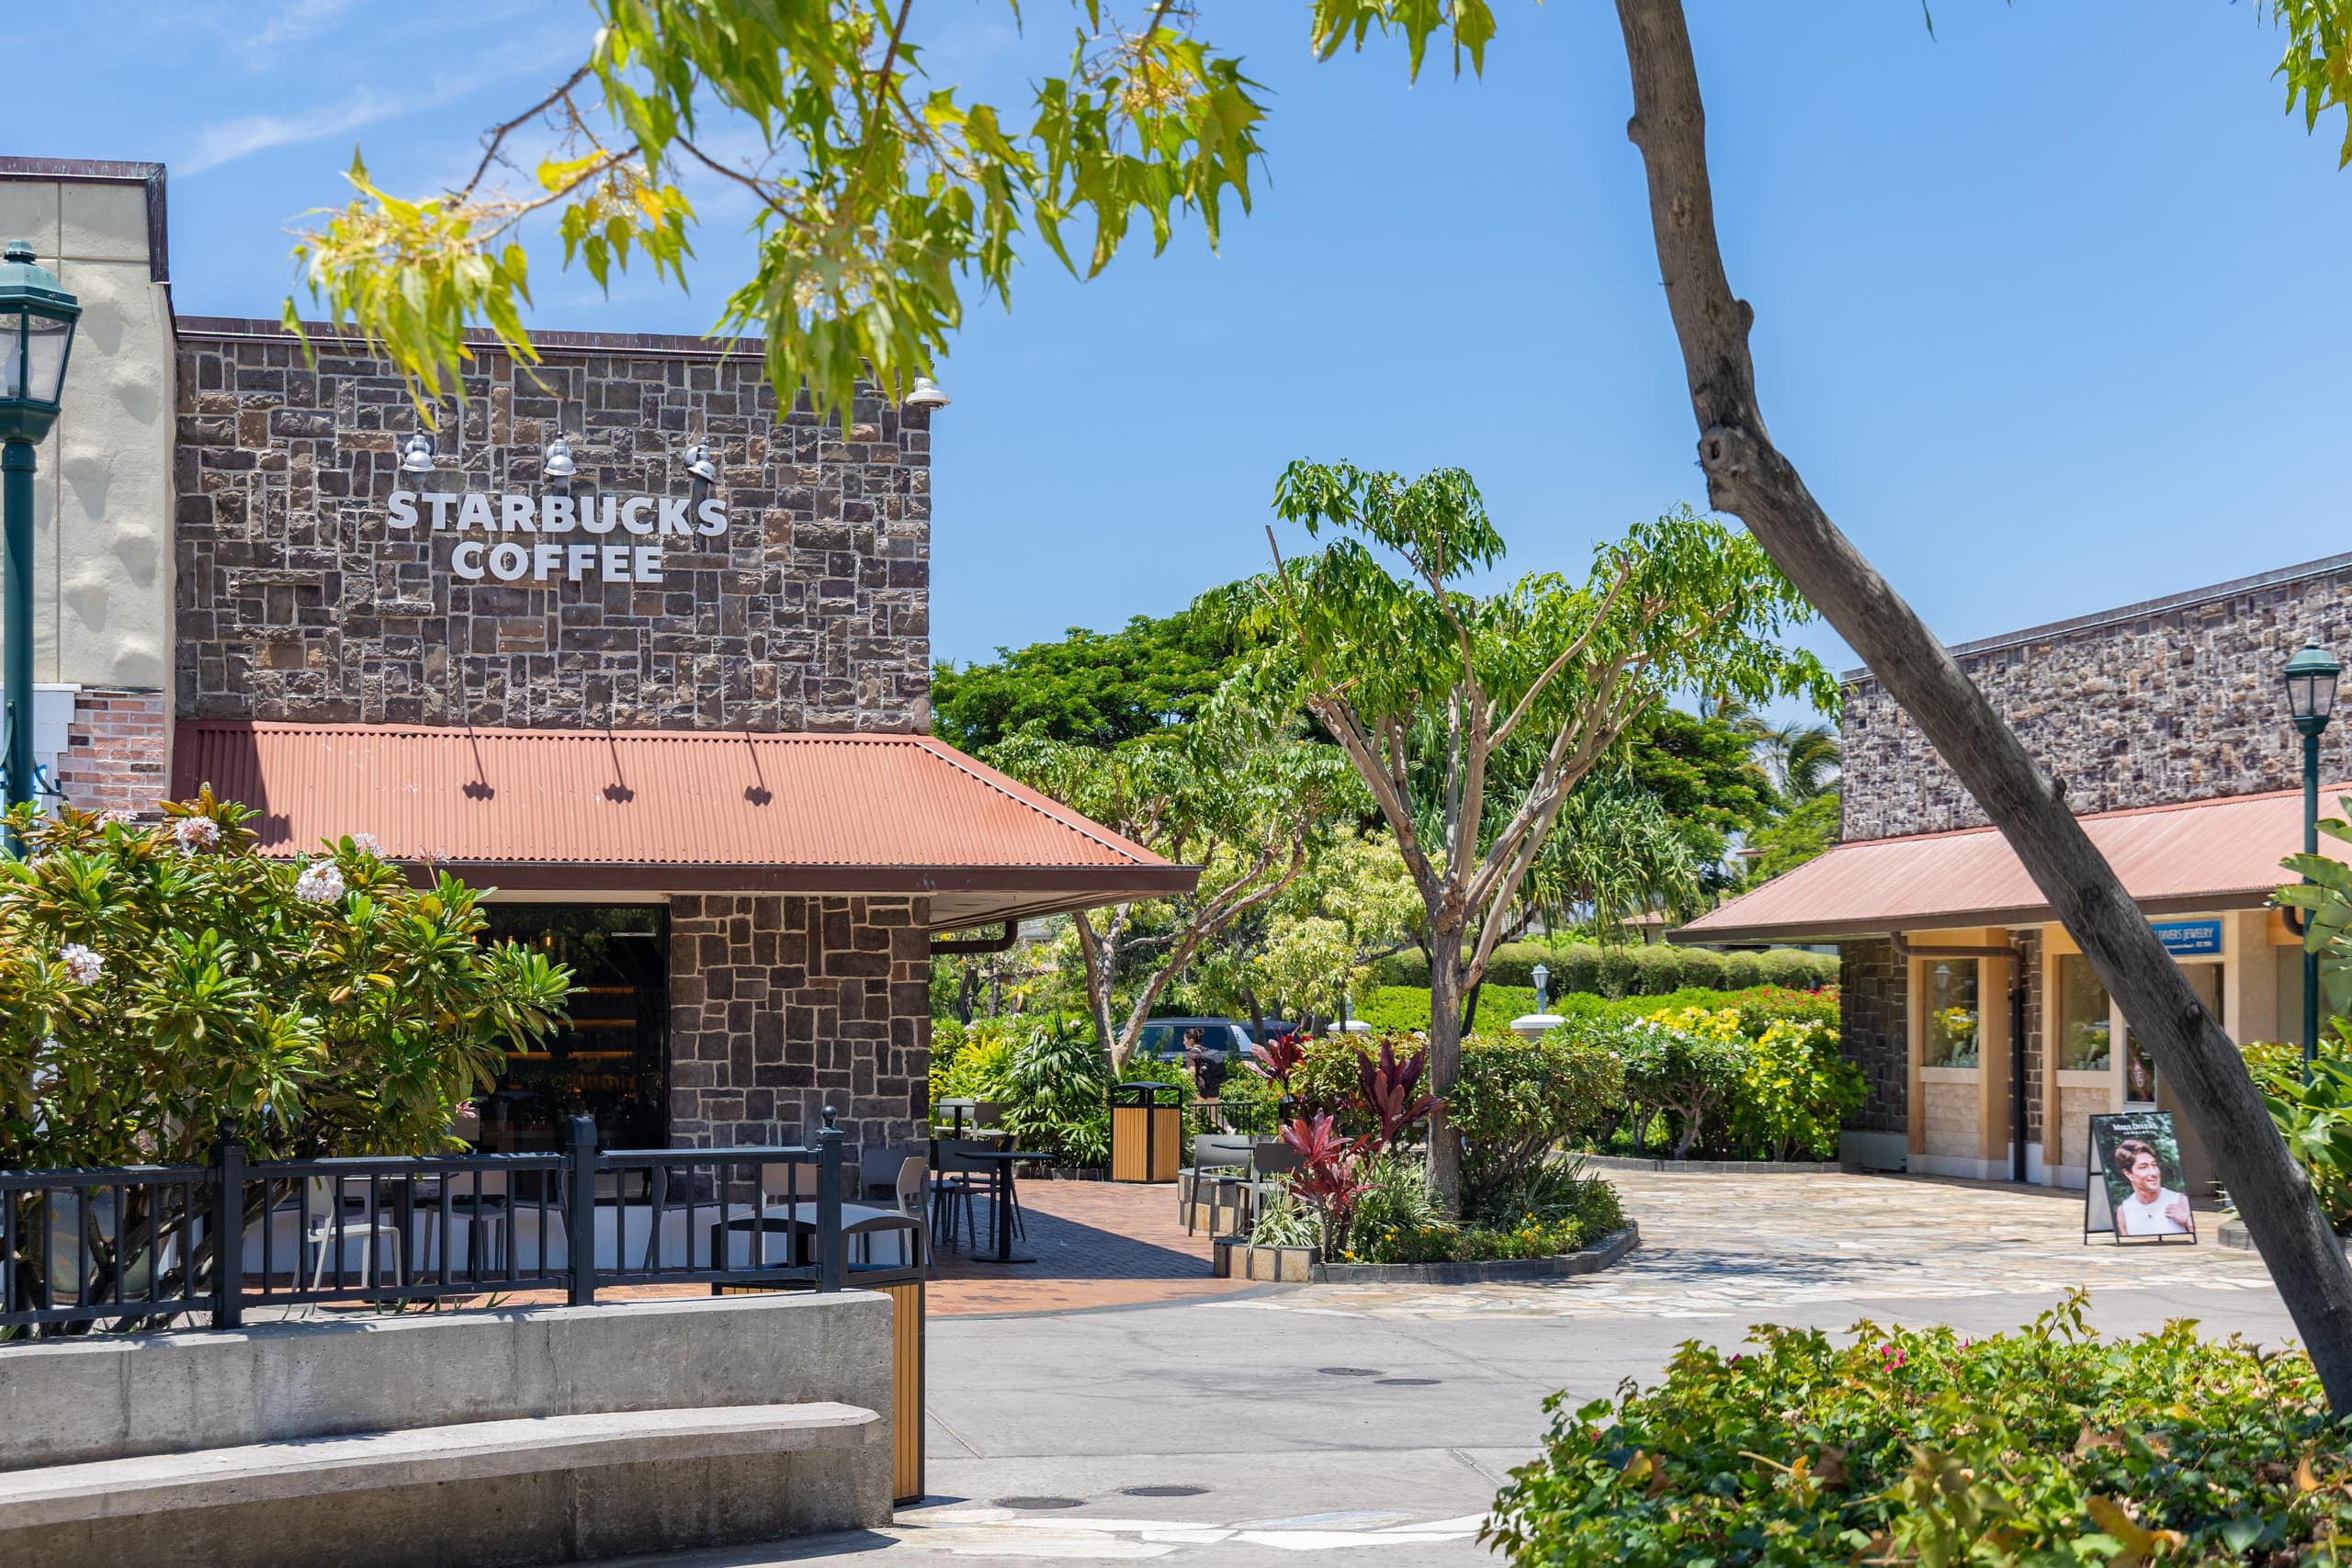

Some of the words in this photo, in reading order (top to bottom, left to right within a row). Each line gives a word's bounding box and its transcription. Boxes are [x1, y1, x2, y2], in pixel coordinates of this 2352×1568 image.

[388, 491, 728, 536] STARBUCKS
[451, 541, 663, 582] COFFEE
[2182, 927, 2213, 941] JEWELRY
